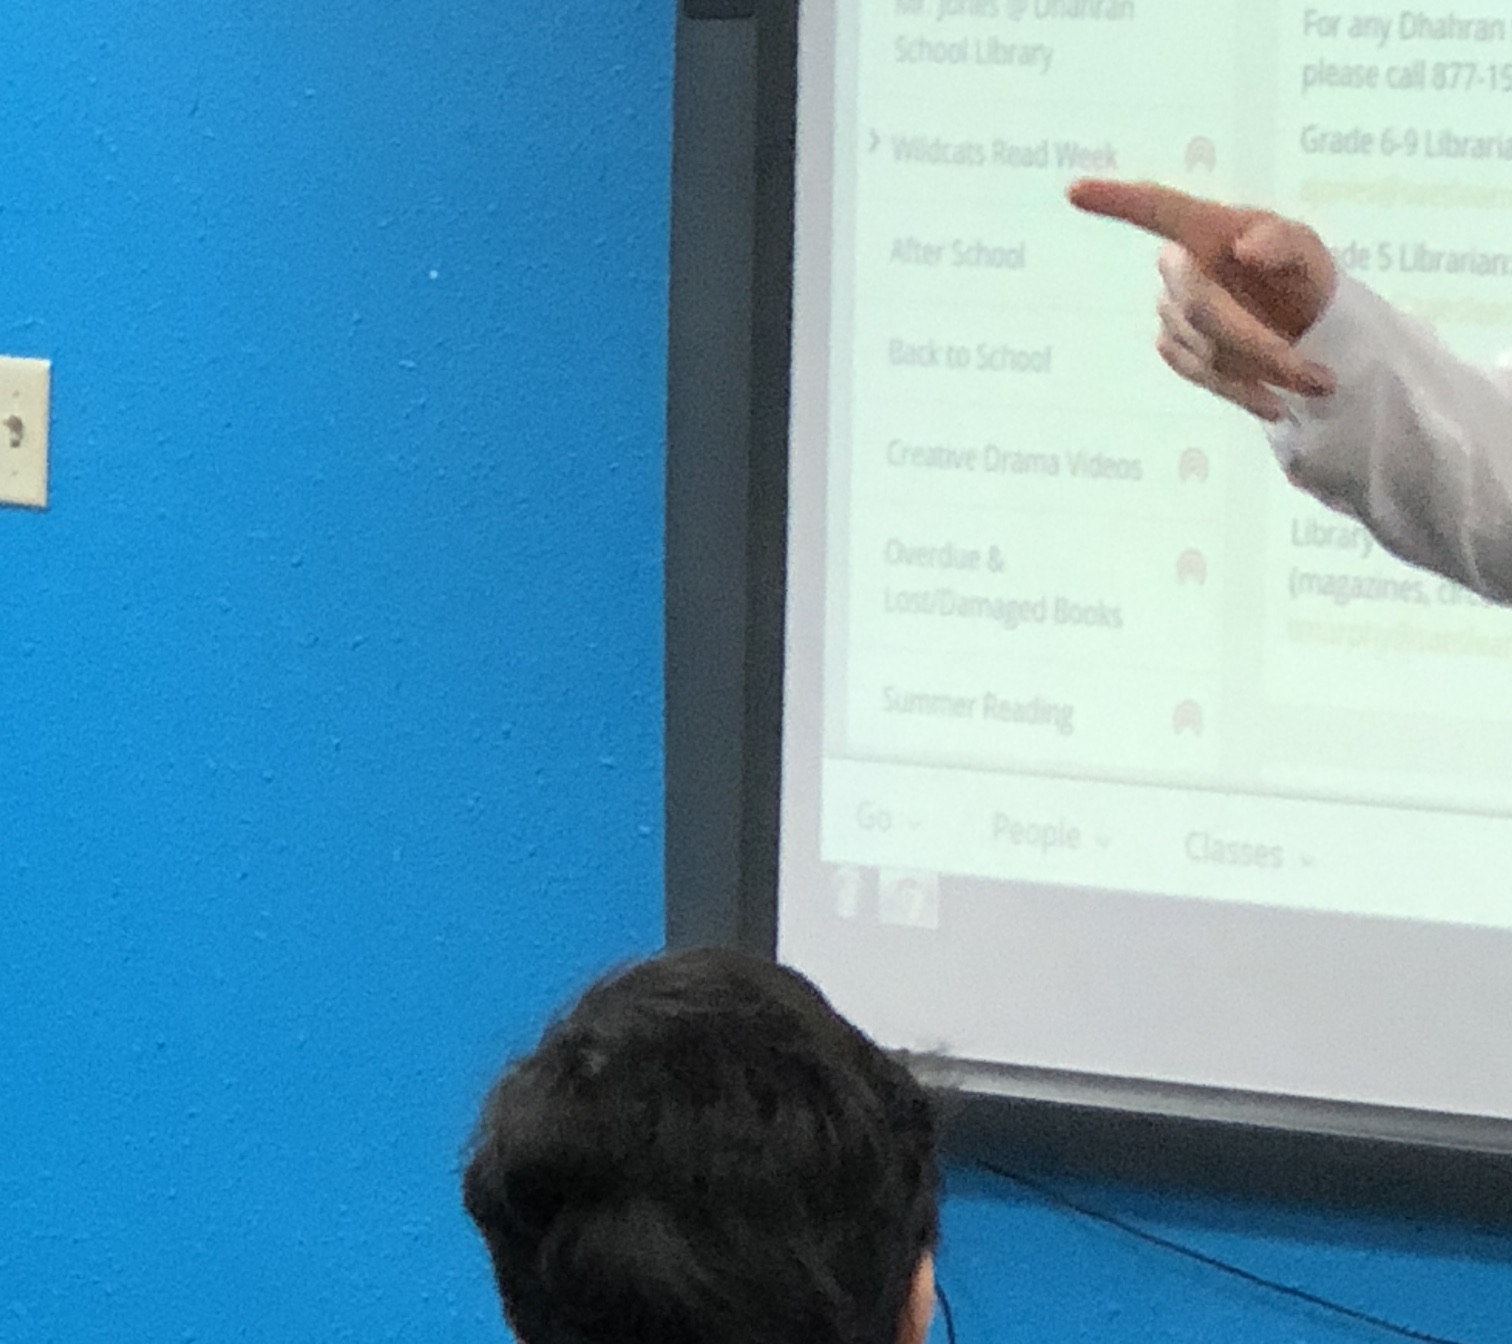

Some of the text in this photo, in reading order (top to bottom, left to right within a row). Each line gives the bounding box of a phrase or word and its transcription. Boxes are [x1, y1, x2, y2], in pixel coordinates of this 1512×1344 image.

[1303, 9, 1343, 40] For
[1347, 15, 1392, 48] any
[1398, 10, 1505, 43] Dhahran
[895, 36, 1053, 74] School Library
[1301, 58, 1377, 96] please
[1386, 60, 1426, 92] call
[892, 133, 1117, 170] Wildcats Read Week
[1300, 124, 1375, 156] Grade
[1380, 126, 1420, 157] 6-9
[890, 236, 1026, 269] After School
[1378, 241, 1392, 273] 5
[889, 337, 1053, 373] Back to School
[886, 437, 1144, 482] Creative Drama Videos
[884, 536, 1005, 574] Overdue &
[1291, 516, 1374, 559] Library
[1288, 565, 1430, 607] (magazines,
[883, 585, 1124, 631] Lost/Damaged Books
[883, 684, 1075, 737] Summer Reading
[856, 800, 893, 833] Go
[993, 811, 1081, 854] People
[1185, 829, 1285, 870] Classes
